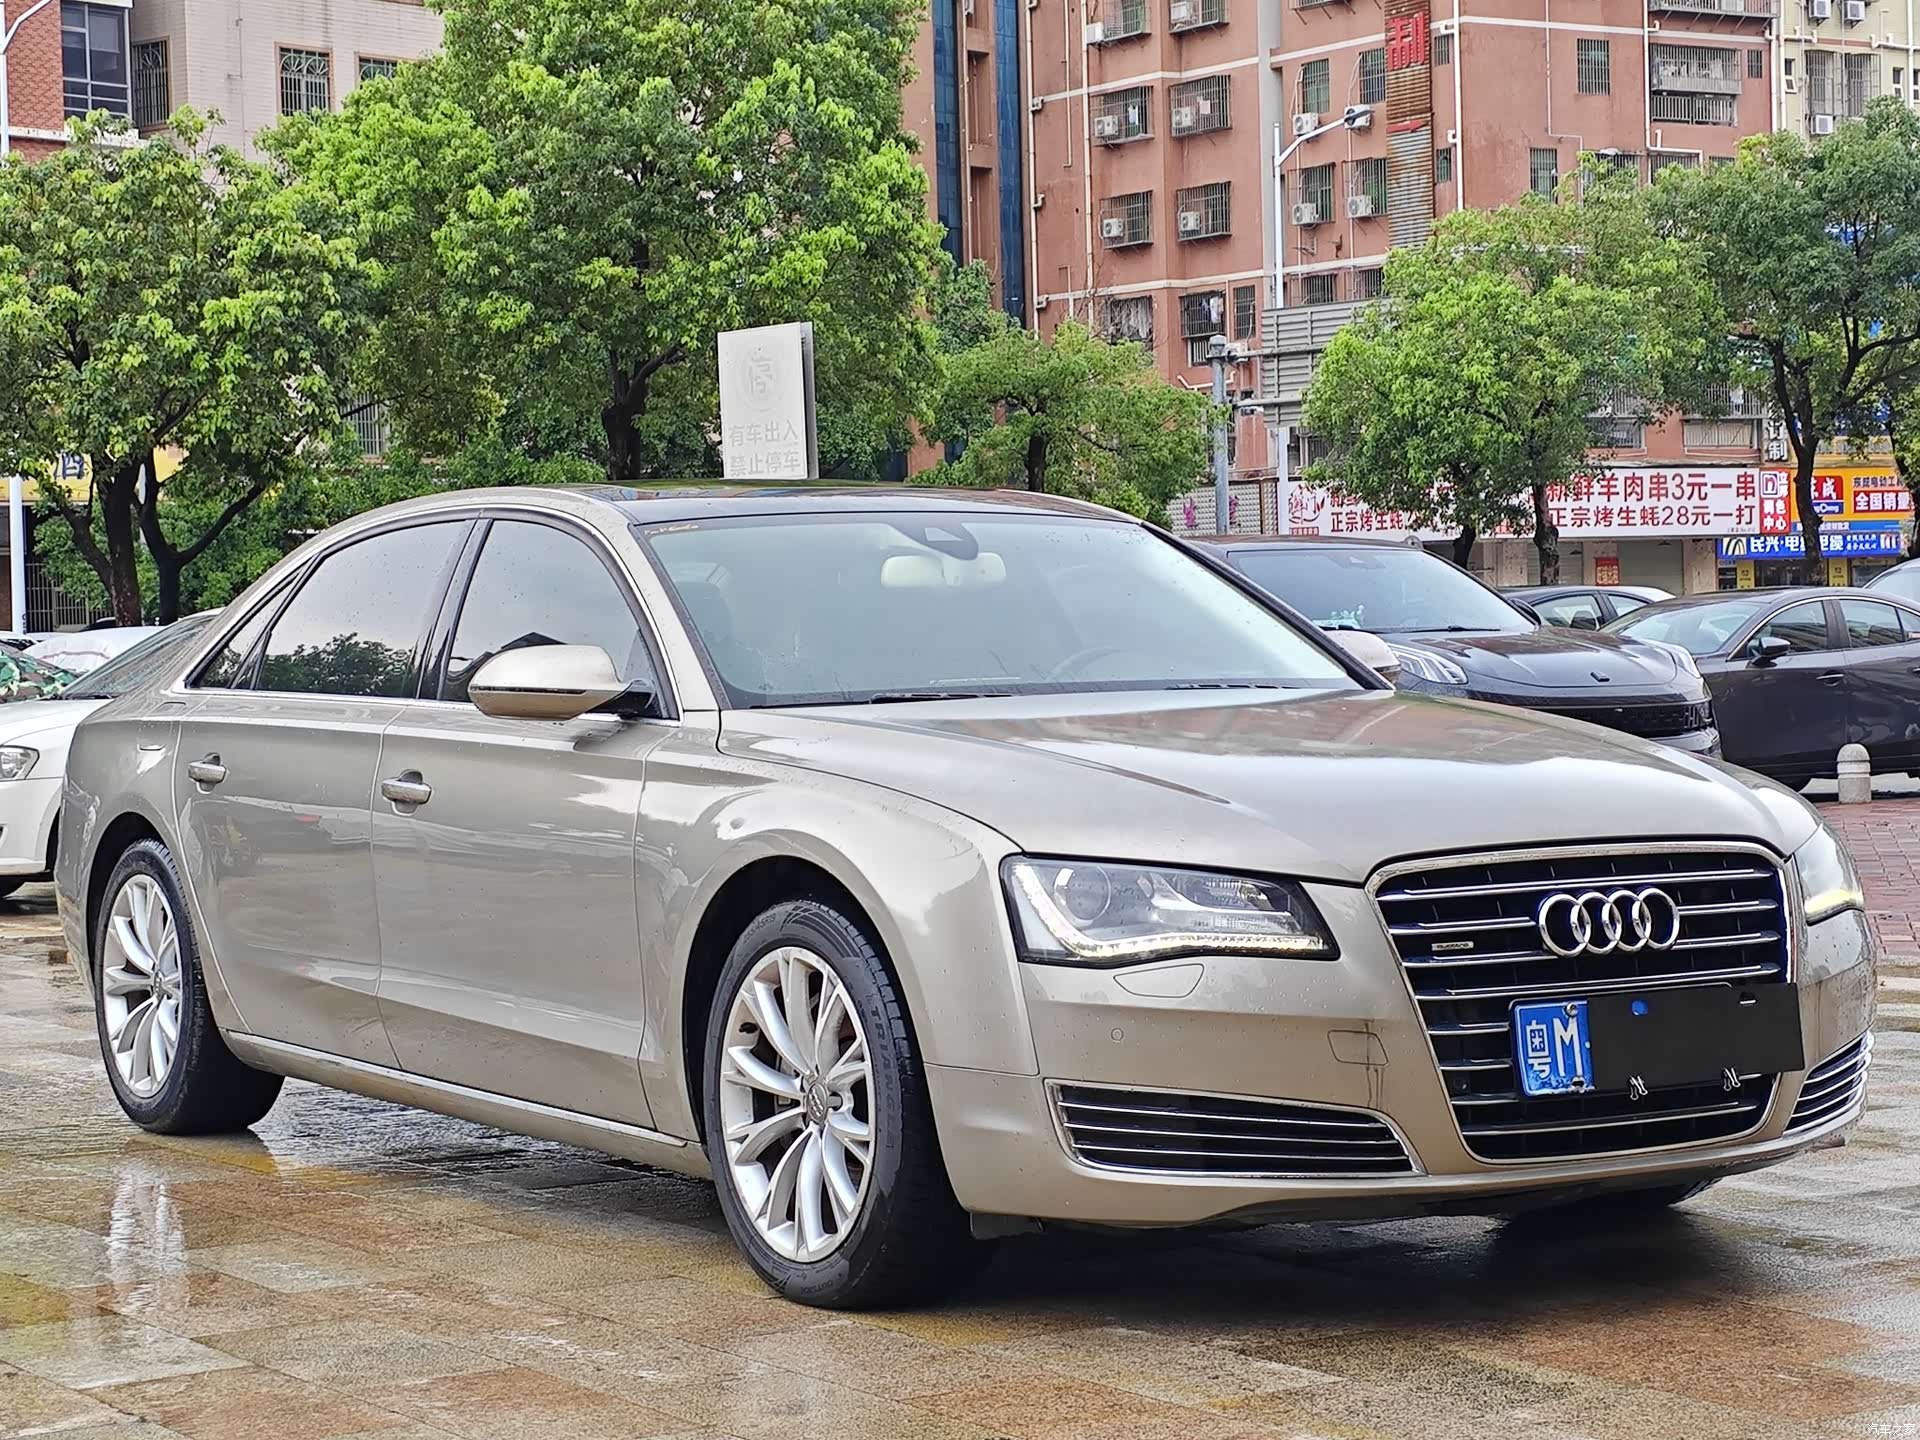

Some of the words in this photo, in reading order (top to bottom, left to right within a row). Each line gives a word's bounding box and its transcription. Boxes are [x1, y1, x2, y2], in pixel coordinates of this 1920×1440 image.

[730, 420, 799, 447] 有车出入
[730, 451, 802, 477] 禁止停车
[1546, 471, 1756, 503] 新鲜羊肉串3元一串
[1549, 504, 1756, 528] 正宗烤生蚝28元一打
[1763, 515, 1786, 531] 中心
[1525, 1017, 1584, 1080] 粤M
